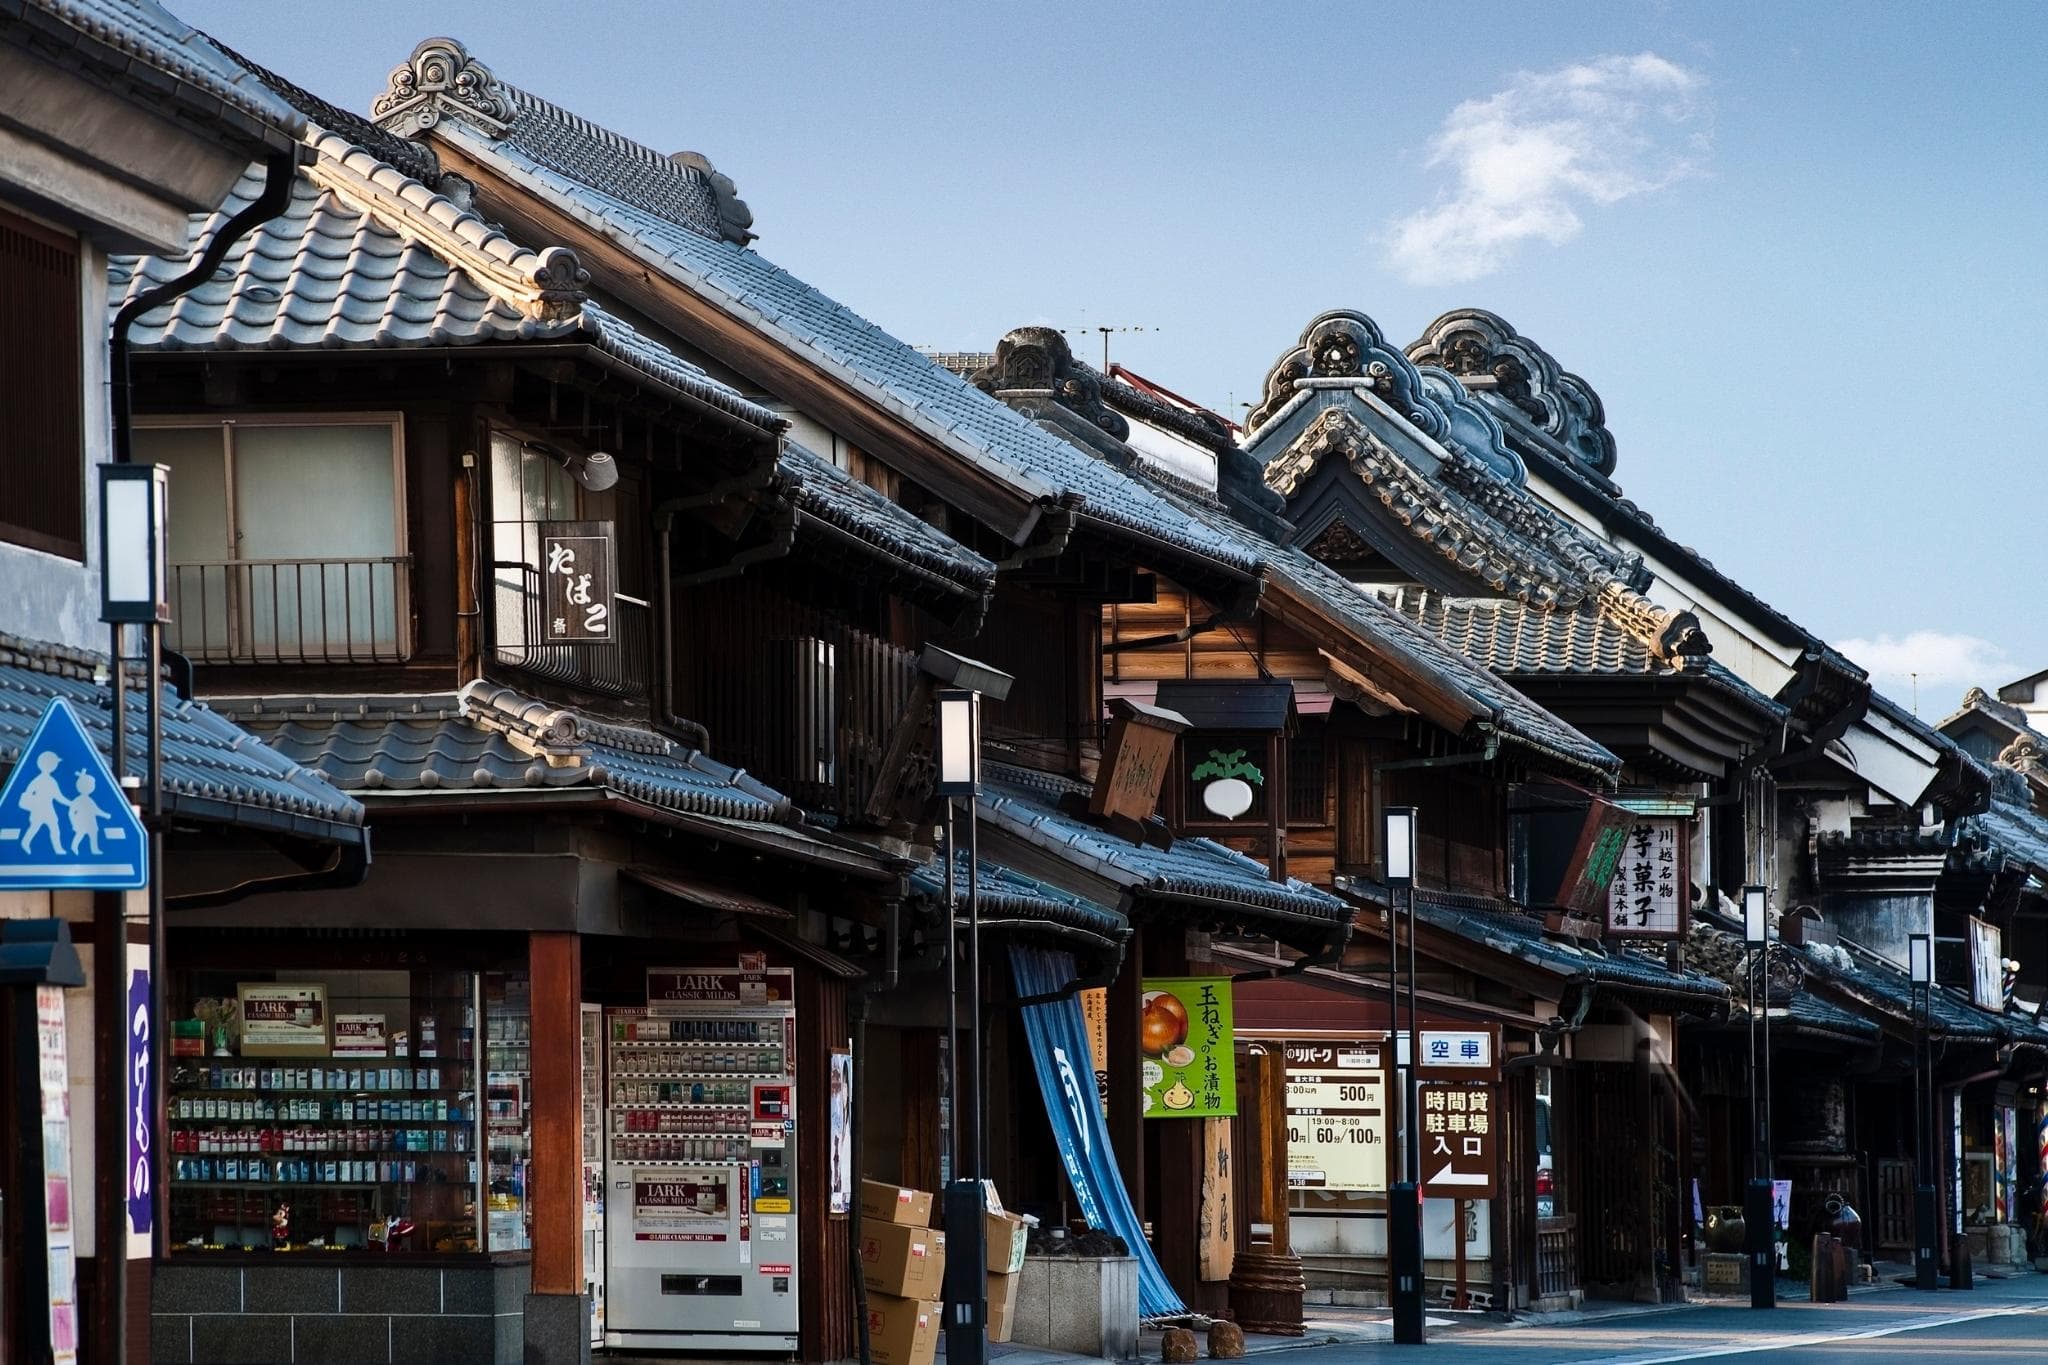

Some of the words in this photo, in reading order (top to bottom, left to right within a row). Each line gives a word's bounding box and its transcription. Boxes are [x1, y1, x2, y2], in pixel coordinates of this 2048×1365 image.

[549, 543, 607, 632] たばこ
[1659, 828, 1674, 898] 川越名物
[1632, 824, 1656, 927] 芋菓子
[676, 975, 724, 990] LARK
[665, 991, 703, 1000] CLASSIC
[706, 991, 736, 1000] MILDS
[254, 1002, 287, 1013] LARK
[1196, 985, 1223, 1110] 玉ねぎのお漬物
[1431, 1040, 1479, 1059] 空車
[1340, 1086, 1374, 1101] 500円
[1425, 1091, 1488, 1112] 時間貸
[1425, 1113, 1488, 1134] 駐車場
[1433, 1136, 1482, 1156] 入口
[648, 1184, 685, 1197] LARK
[639, 1197, 668, 1205] CLASSIC
[670, 1197, 695, 1205] MILDS
